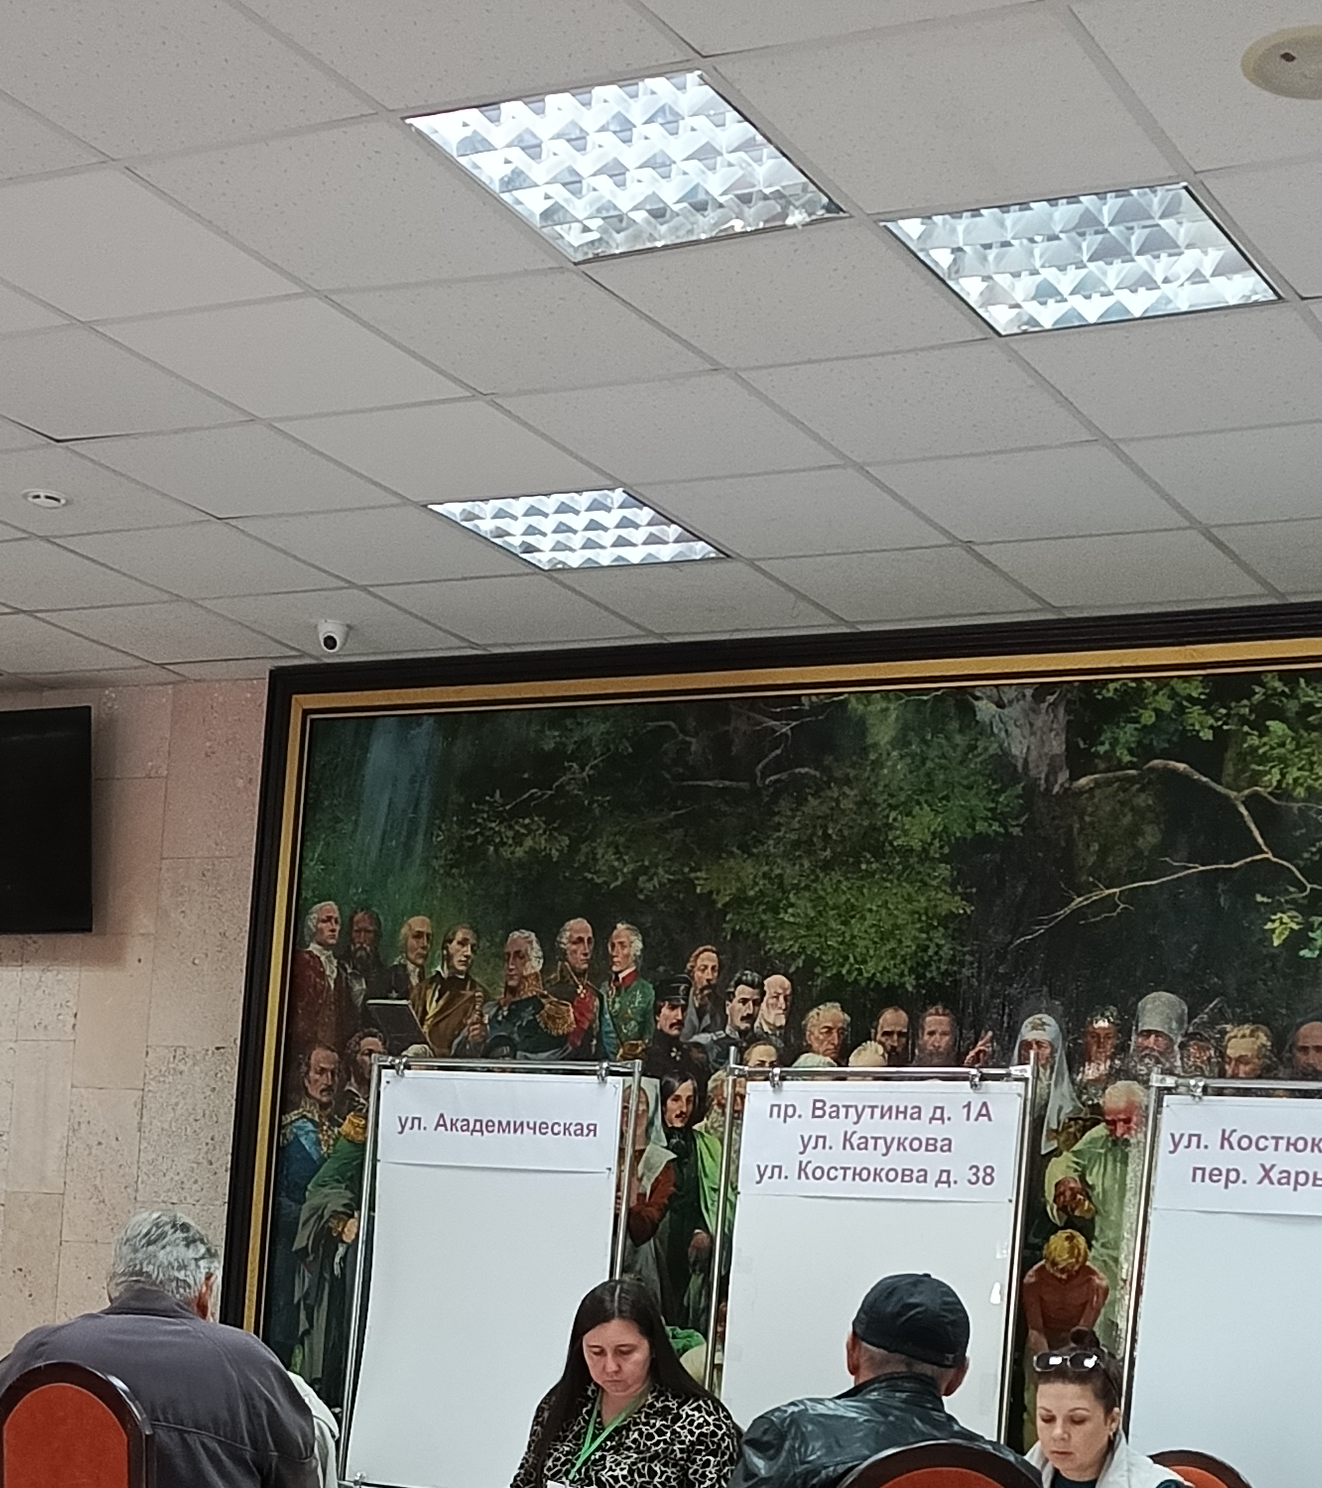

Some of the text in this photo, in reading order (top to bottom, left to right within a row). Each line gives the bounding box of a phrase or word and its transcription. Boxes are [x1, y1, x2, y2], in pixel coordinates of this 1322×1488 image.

[397, 1112, 598, 1138] ул. Академическая
[768, 1099, 993, 1125] пр. Ватутина д. 1А
[798, 1130, 953, 1156] ул. Катукова
[1168, 1132, 1210, 1155] ул.
[755, 1160, 995, 1187] ул. Костюкова д. 38
[1191, 1166, 1247, 1190] пер.
